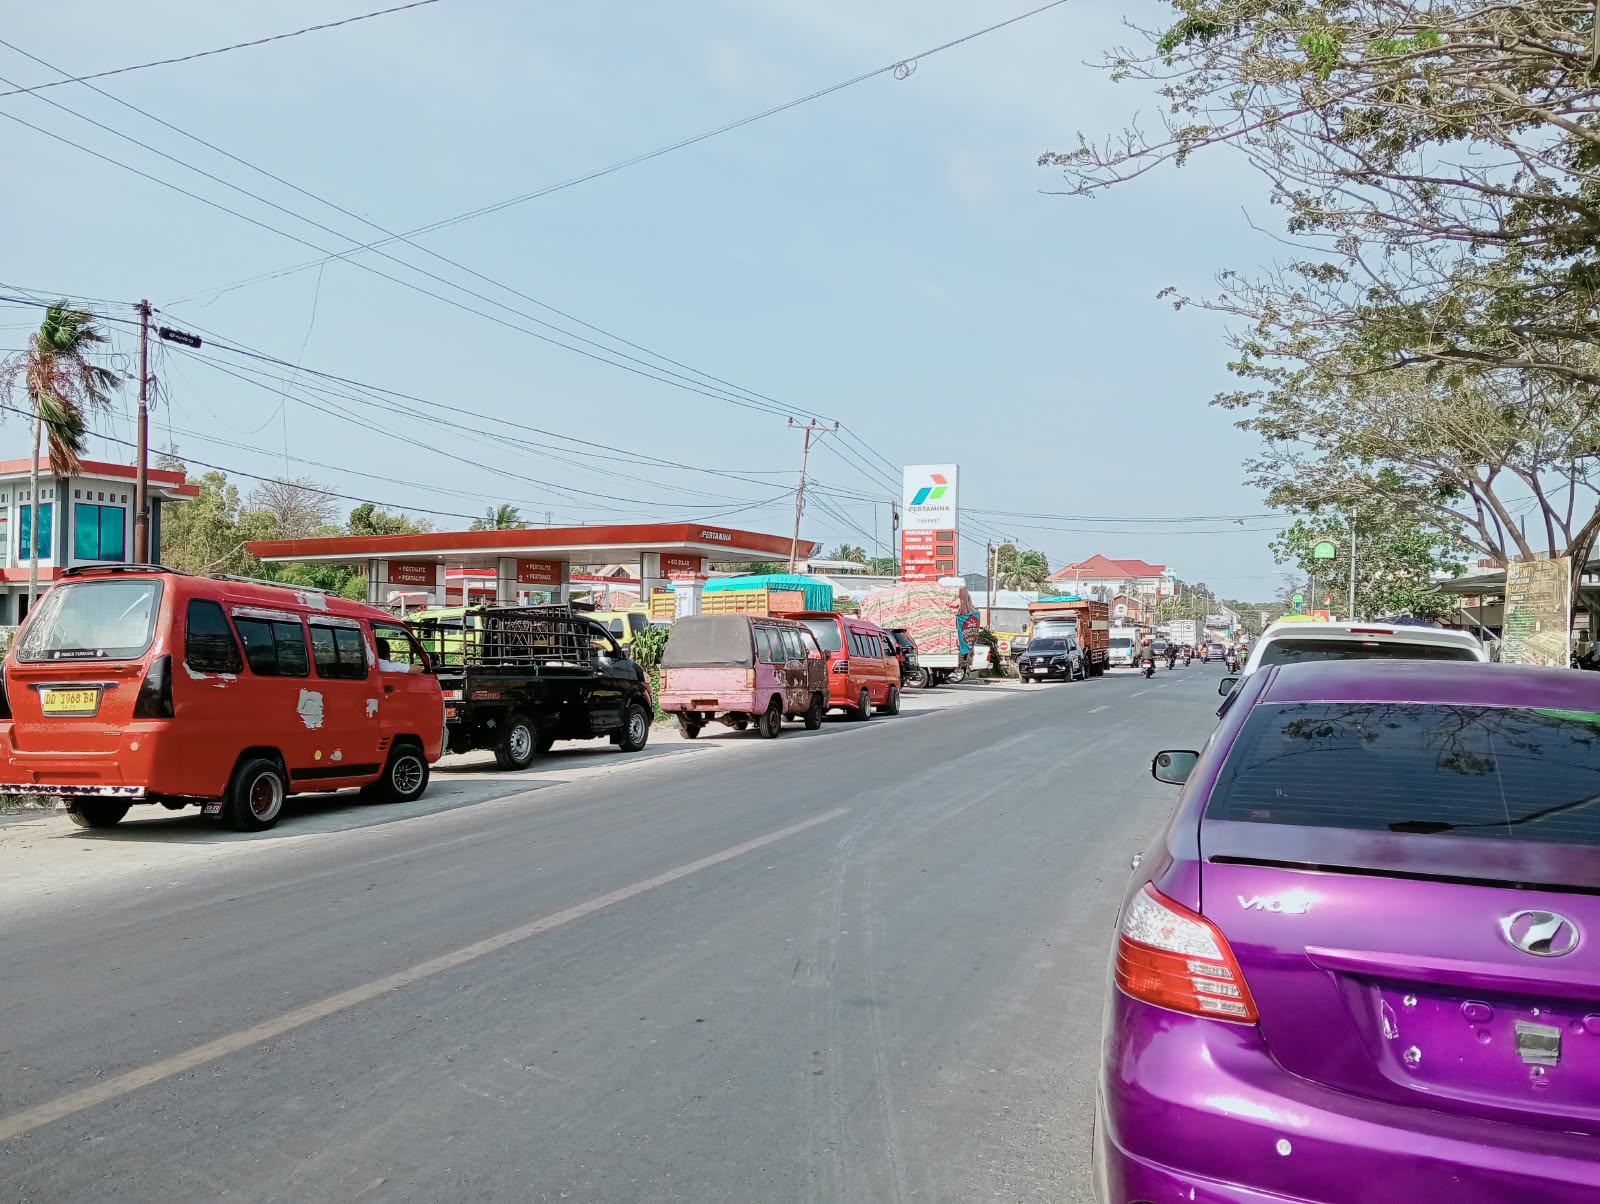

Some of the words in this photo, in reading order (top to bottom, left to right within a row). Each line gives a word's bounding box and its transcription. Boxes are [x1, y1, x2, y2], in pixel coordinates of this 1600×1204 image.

[702, 530, 732, 541] PERTAMINA
[402, 565, 426, 573] PERTALITE
[529, 563, 552, 571] PERTALITE
[402, 574, 426, 582] PERTALITE
[518, 574, 523, 583] 2
[45, 693, 56, 705] DD
[83, 692, 94, 704] BA
[1237, 895, 1306, 914] VIO
